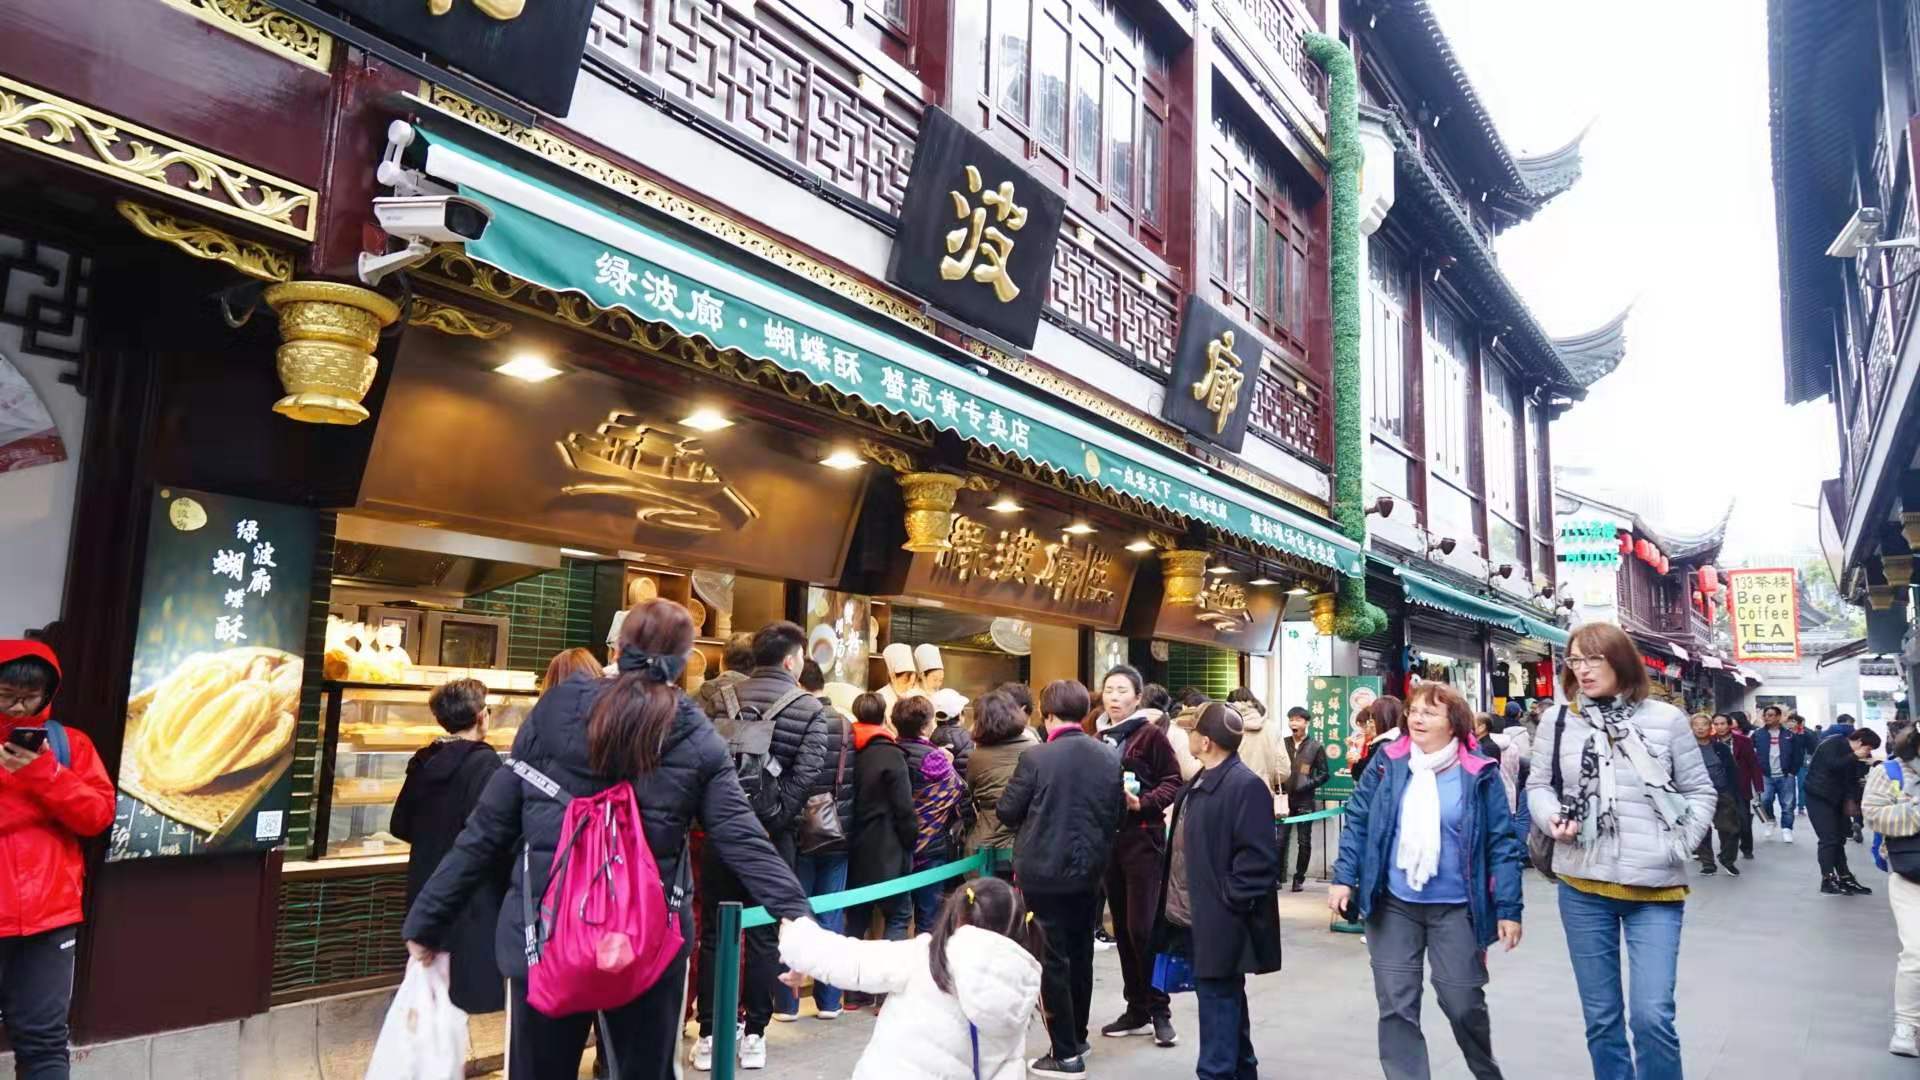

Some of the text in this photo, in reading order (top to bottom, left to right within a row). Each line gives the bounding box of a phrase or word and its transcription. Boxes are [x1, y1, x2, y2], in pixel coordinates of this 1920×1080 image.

[940, 164, 1245, 435] 波 廊
[880, 366, 1030, 450] 蟹壳黄专卖店
[236, 519, 277, 598] 绿波廊
[212, 549, 247, 644] 蝴蝶酥
[1735, 576, 1789, 590] 133茶楼
[1737, 591, 1787, 604] Beer
[1738, 607, 1789, 620] Coffee
[1739, 623, 1785, 637] TEA
